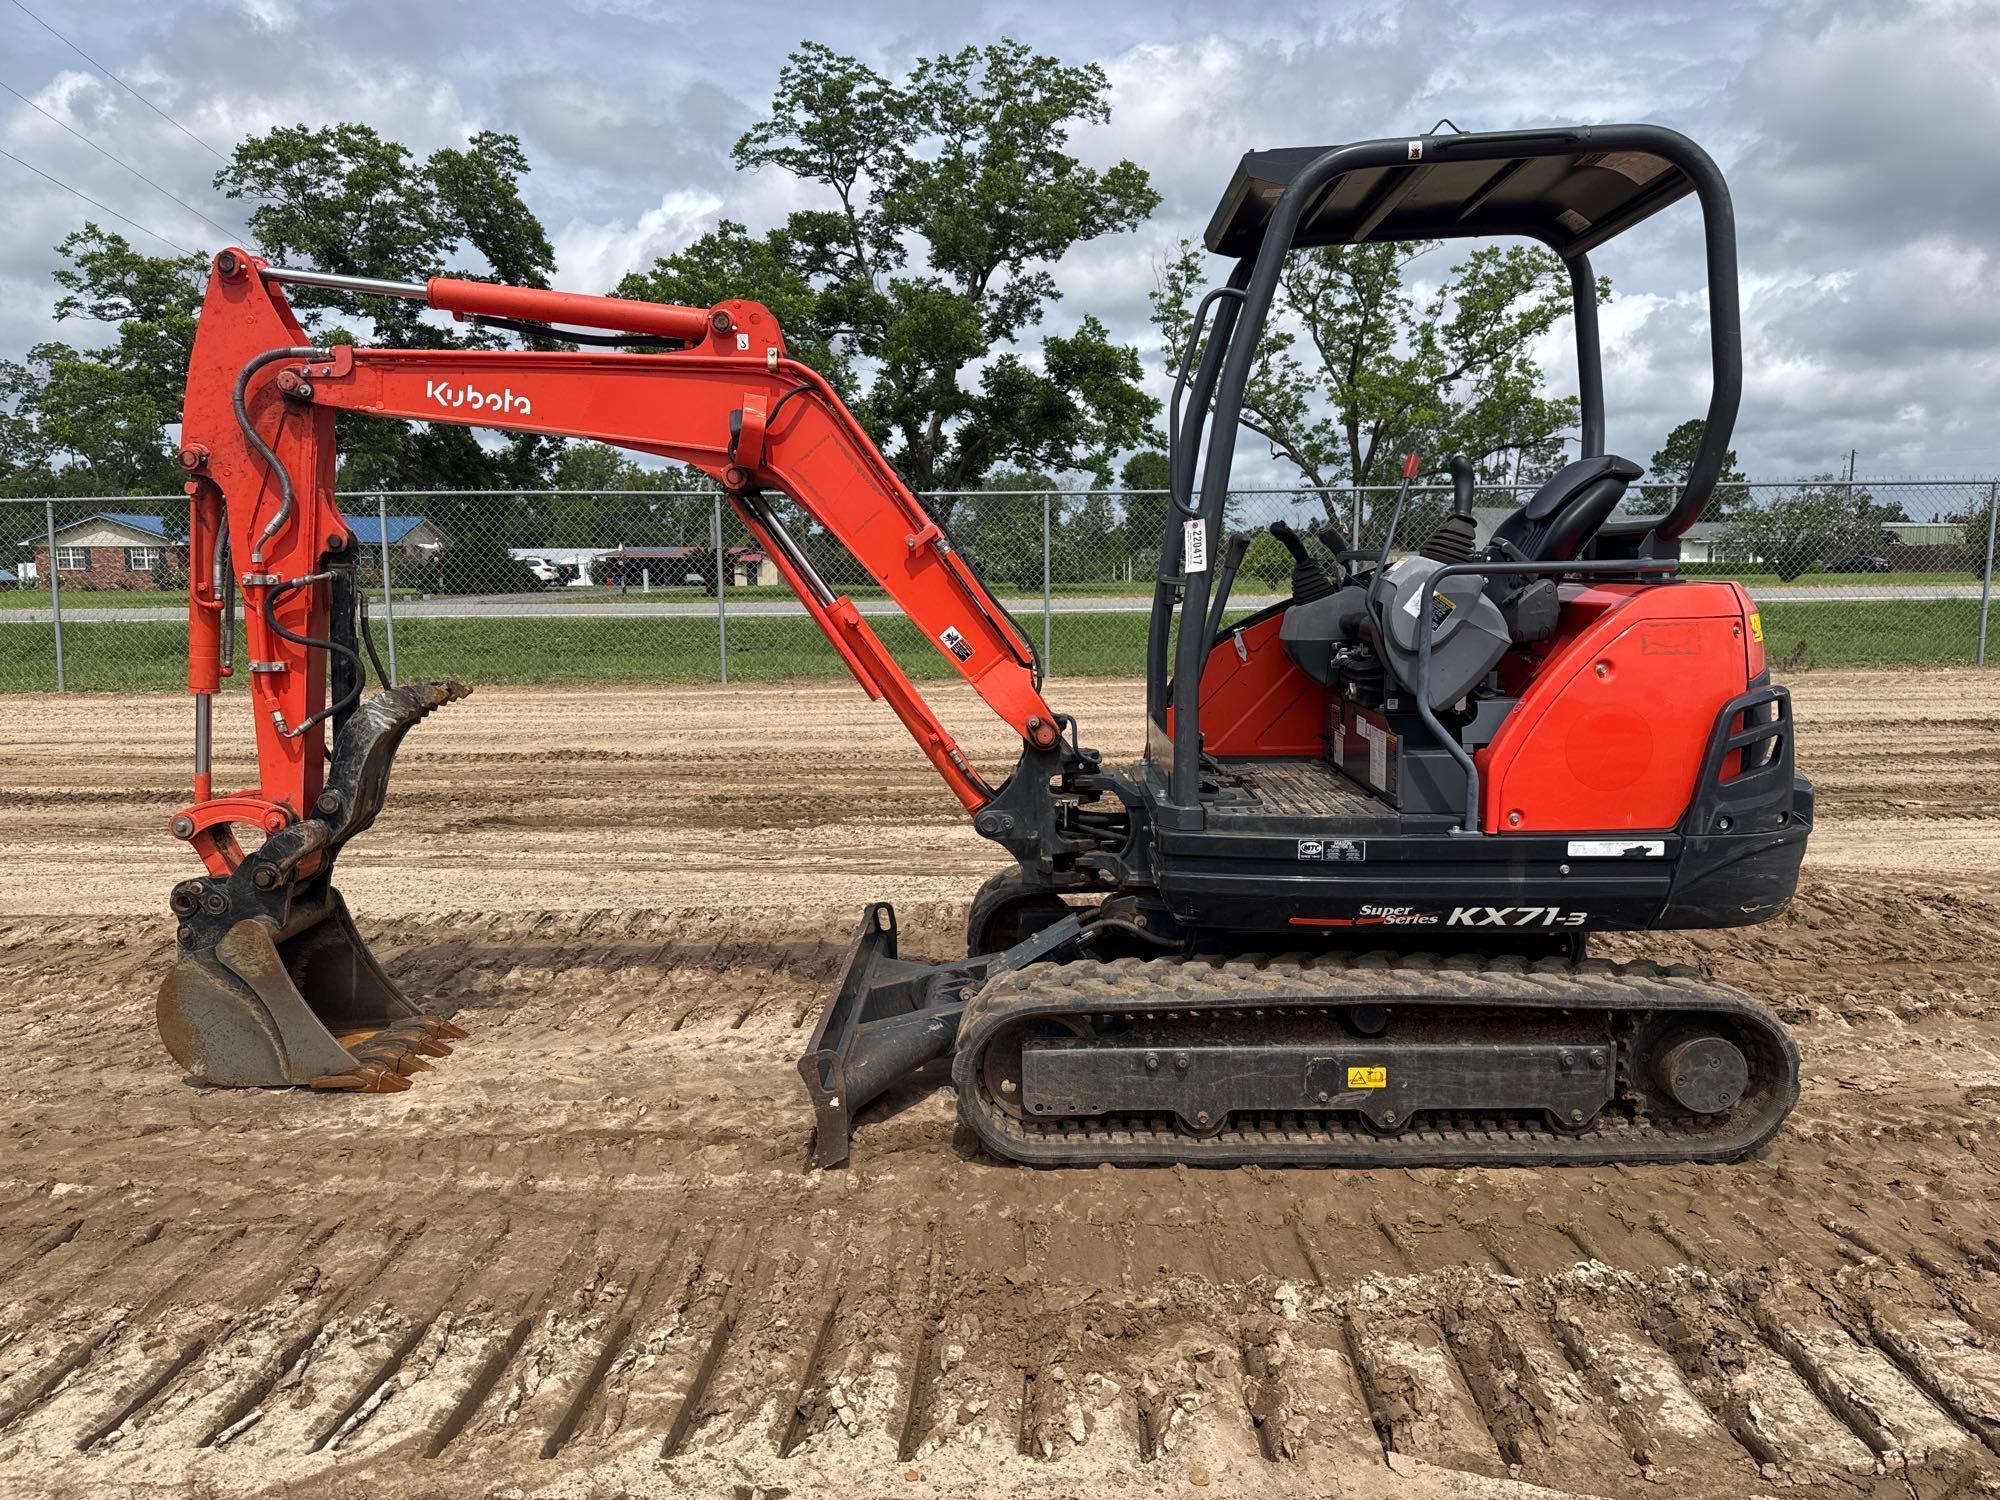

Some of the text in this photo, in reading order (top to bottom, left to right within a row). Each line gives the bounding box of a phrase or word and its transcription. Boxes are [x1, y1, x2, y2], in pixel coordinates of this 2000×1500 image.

[426, 380, 531, 415] Kubota
[1192, 530, 1203, 565] 220417
[1358, 904, 1414, 917] Super
[1383, 914, 1439, 925] Series
[1446, 907, 1588, 926] KX71-3
